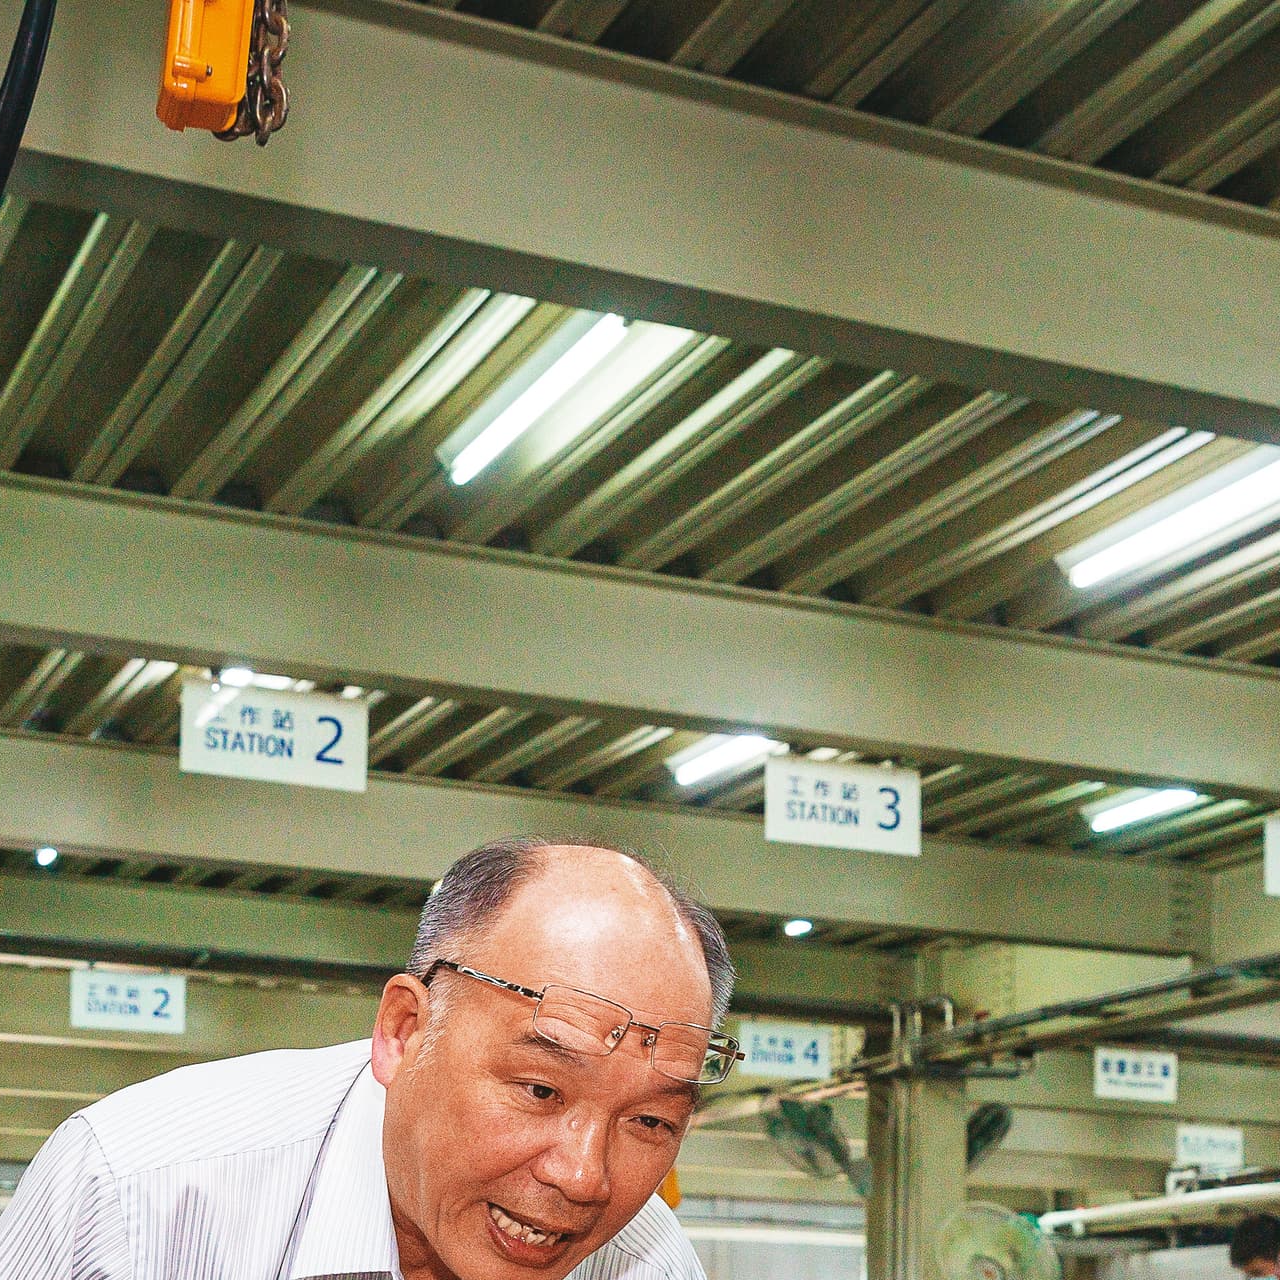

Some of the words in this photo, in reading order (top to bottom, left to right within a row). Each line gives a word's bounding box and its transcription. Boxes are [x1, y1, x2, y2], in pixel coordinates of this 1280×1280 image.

[208, 704, 294, 732] 作站
[205, 726, 294, 759] STATION
[315, 715, 345, 765] 2
[786, 799, 861, 826] STATION
[877, 785, 902, 832] 3
[152, 986, 171, 1019] 2
[802, 1039, 819, 1067] 4
